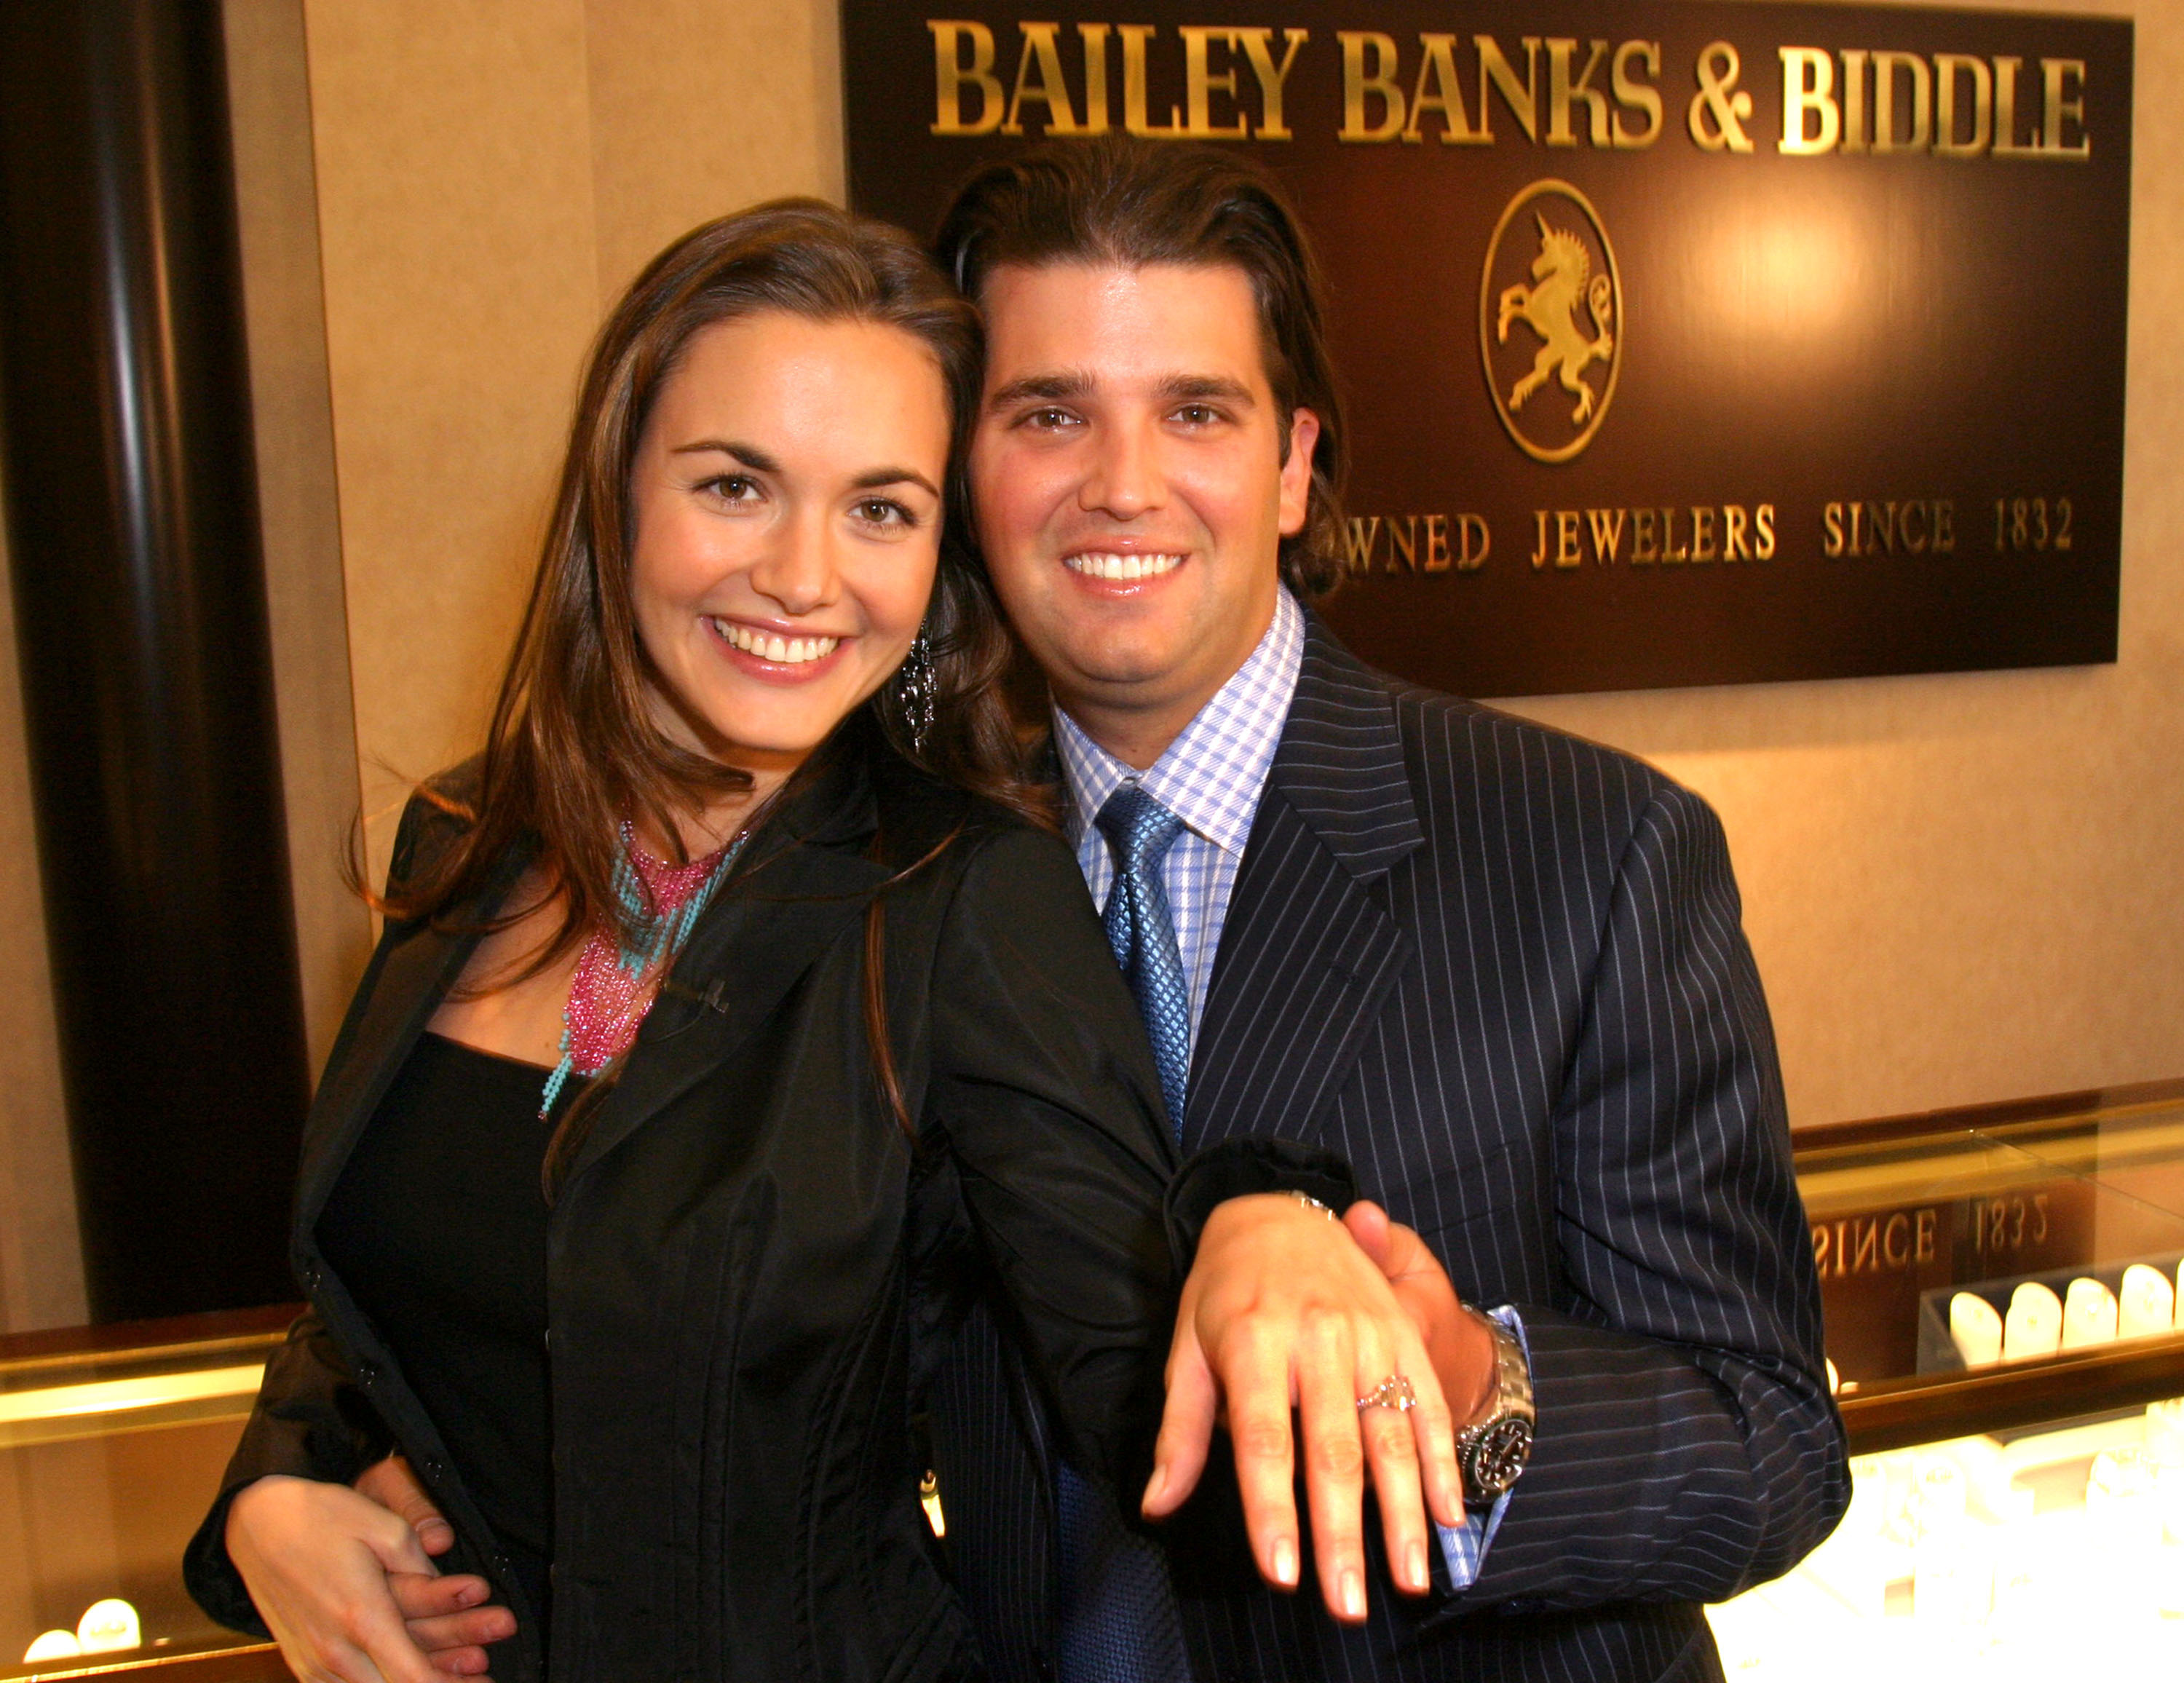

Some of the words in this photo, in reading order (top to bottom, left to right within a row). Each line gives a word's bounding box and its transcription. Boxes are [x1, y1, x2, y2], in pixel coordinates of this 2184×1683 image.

[927, 20, 1308, 140] BAILEY
[1337, 31, 1662, 148] BANKS
[1689, 41, 1754, 153] &
[1779, 47, 2090, 161] BIDDLE
[1328, 514, 1490, 574] WNED
[1532, 505, 1776, 568] JEWELERS
[1824, 500, 1956, 558] SINCE
[1995, 497, 2073, 551] 1832
